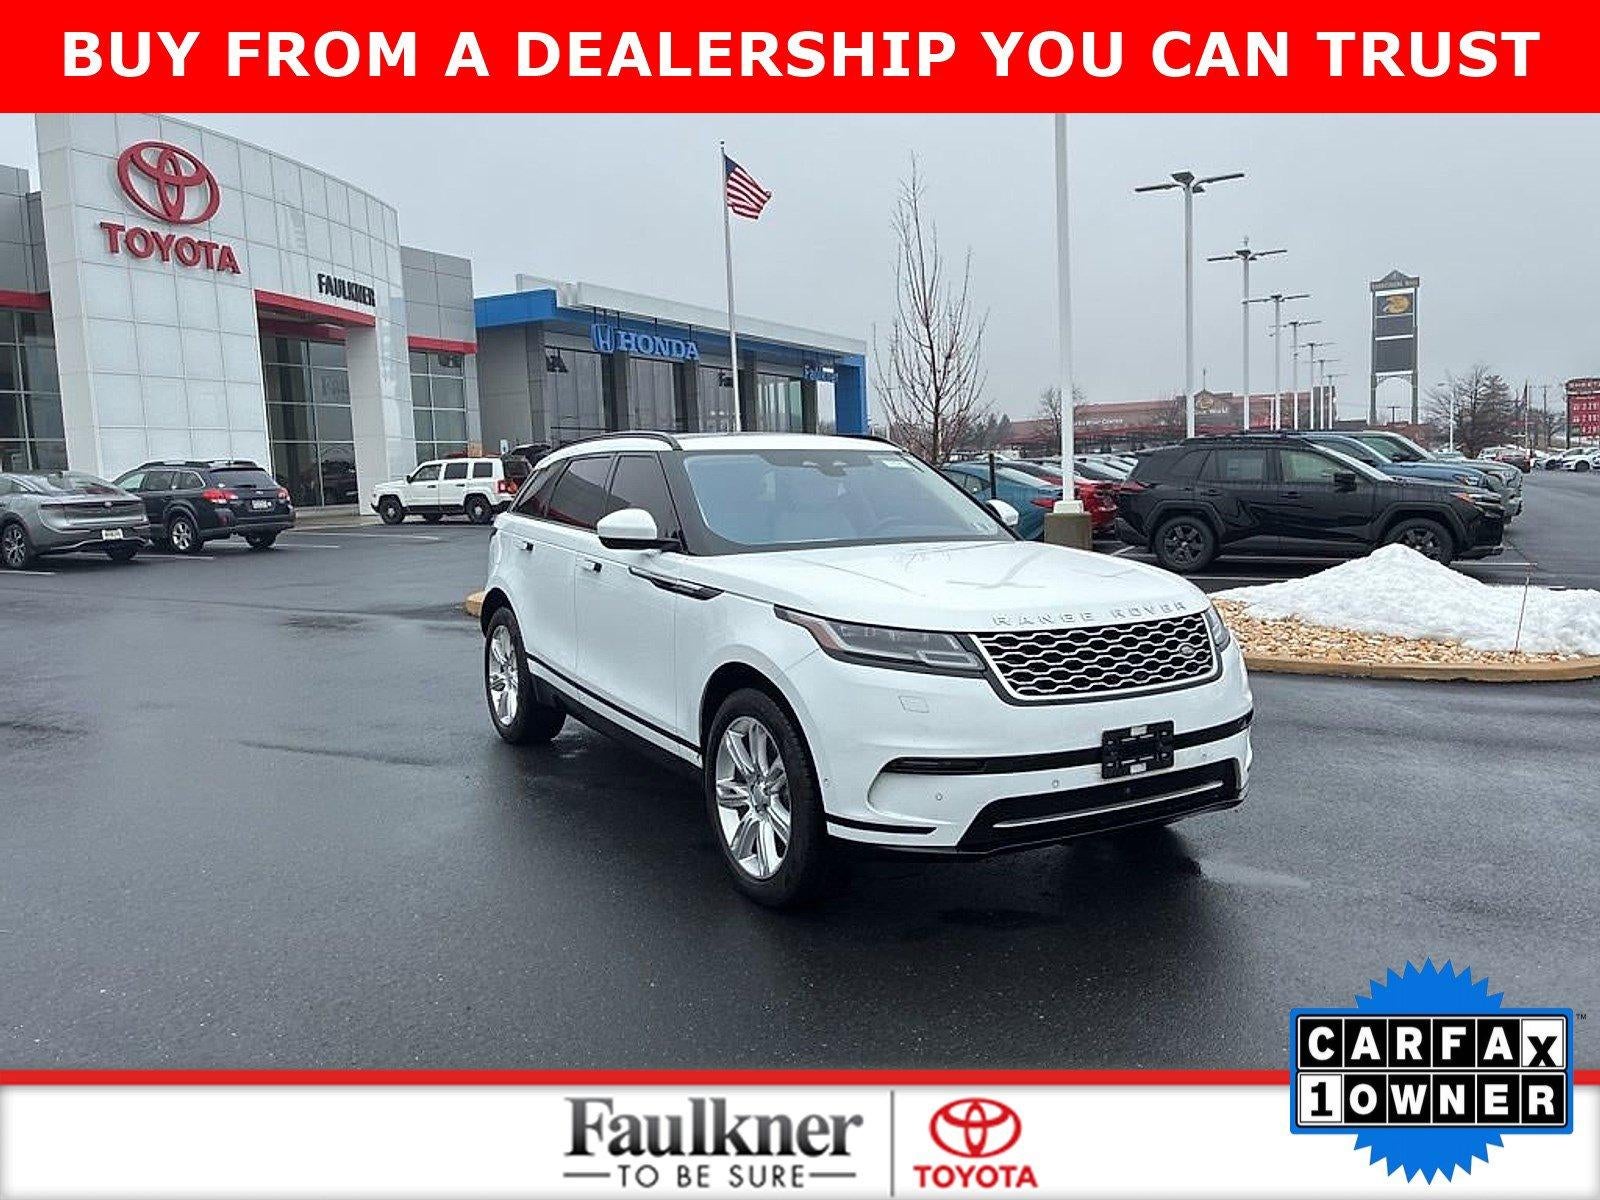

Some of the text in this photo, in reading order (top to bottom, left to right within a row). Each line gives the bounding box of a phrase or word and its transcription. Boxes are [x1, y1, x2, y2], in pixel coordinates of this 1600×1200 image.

[100, 221, 241, 274] TOYOTA
[317, 272, 376, 308] FAULKNER
[617, 330, 699, 361] HONDA
[993, 601, 1187, 627] RANGE ROVER
